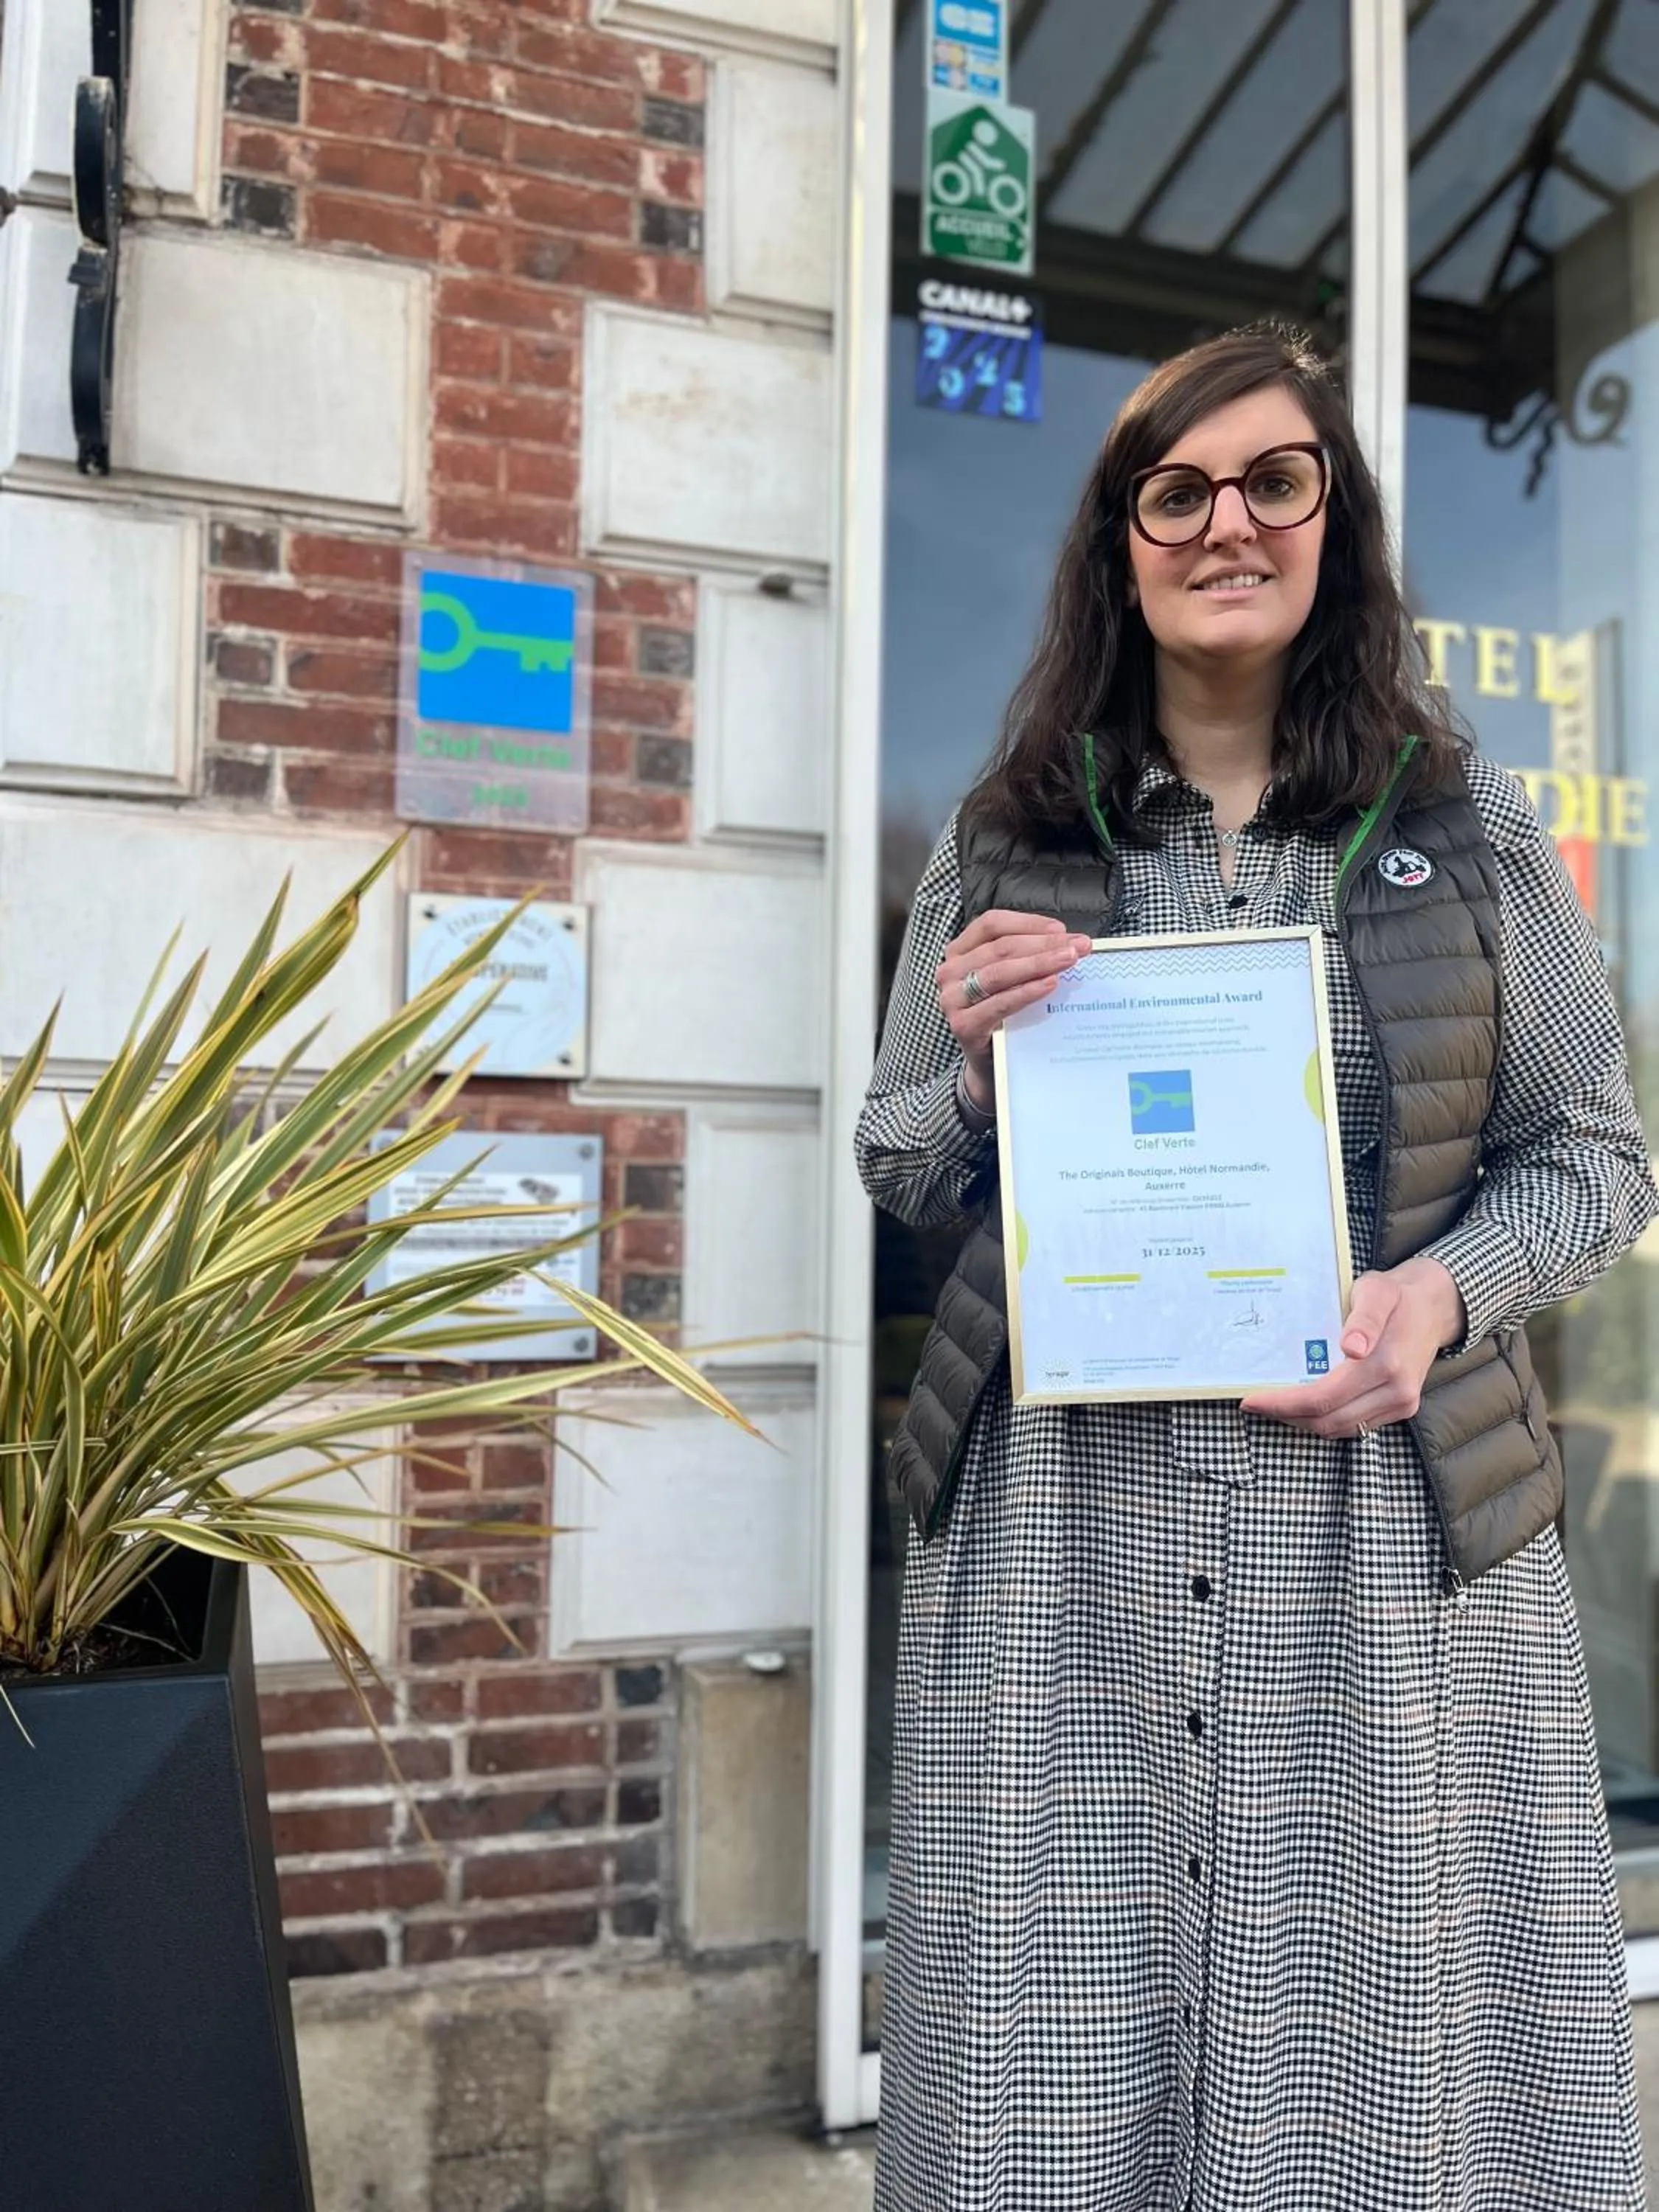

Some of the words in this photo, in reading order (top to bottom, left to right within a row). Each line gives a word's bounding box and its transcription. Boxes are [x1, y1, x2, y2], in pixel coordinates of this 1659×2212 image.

[919, 279, 1032, 323] CANAL+
[1047, 998, 1127, 1014] International
[1130, 992, 1220, 1009] Environmental
[1223, 990, 1263, 1004] Award
[1134, 1137, 1160, 1150] Clef
[1163, 1136, 1196, 1149] Verte
[1060, 1171, 1078, 1180] The
[1080, 1169, 1125, 1180] Originals
[1128, 1166, 1177, 1178] Boutique,
[1209, 1162, 1270, 1174] Normandie,
[1145, 1181, 1186, 1191] Auxerre
